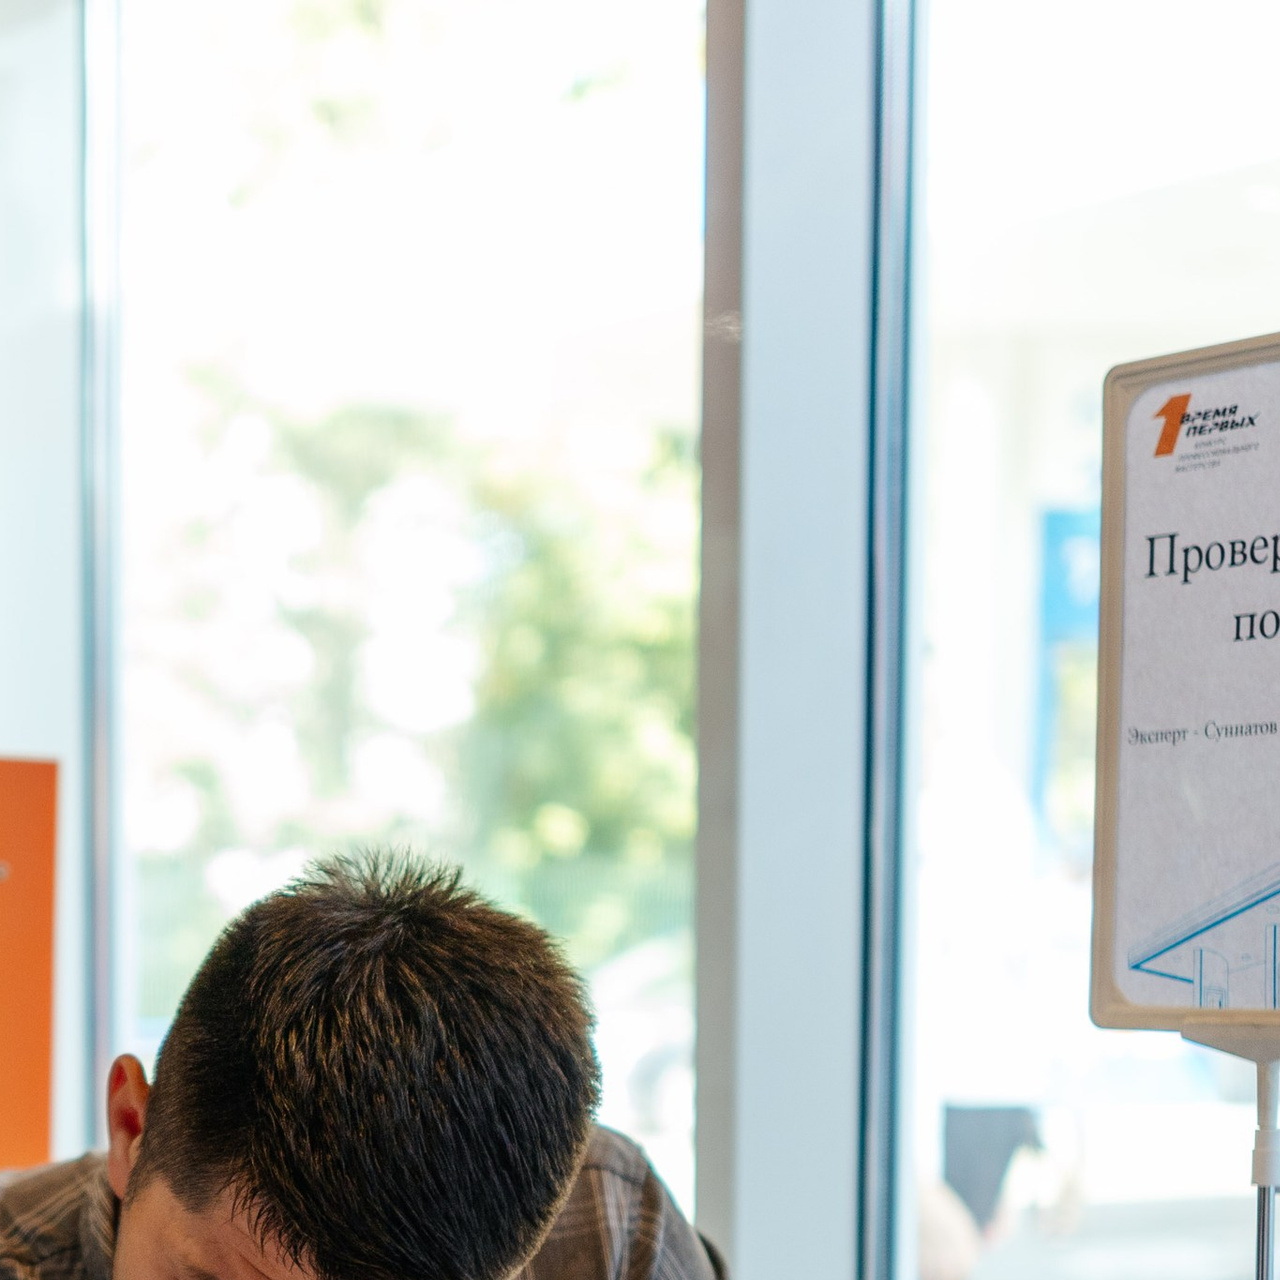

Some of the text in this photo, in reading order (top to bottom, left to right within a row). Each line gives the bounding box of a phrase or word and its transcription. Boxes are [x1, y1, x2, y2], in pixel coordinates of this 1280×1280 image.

[1181, 405, 1238, 425] ВРЕМЯ
[1186, 412, 1259, 438] ПЕРВЫХ
[1127, 727, 1189, 747] Эксперт
[1204, 719, 1278, 743] Суннатов
